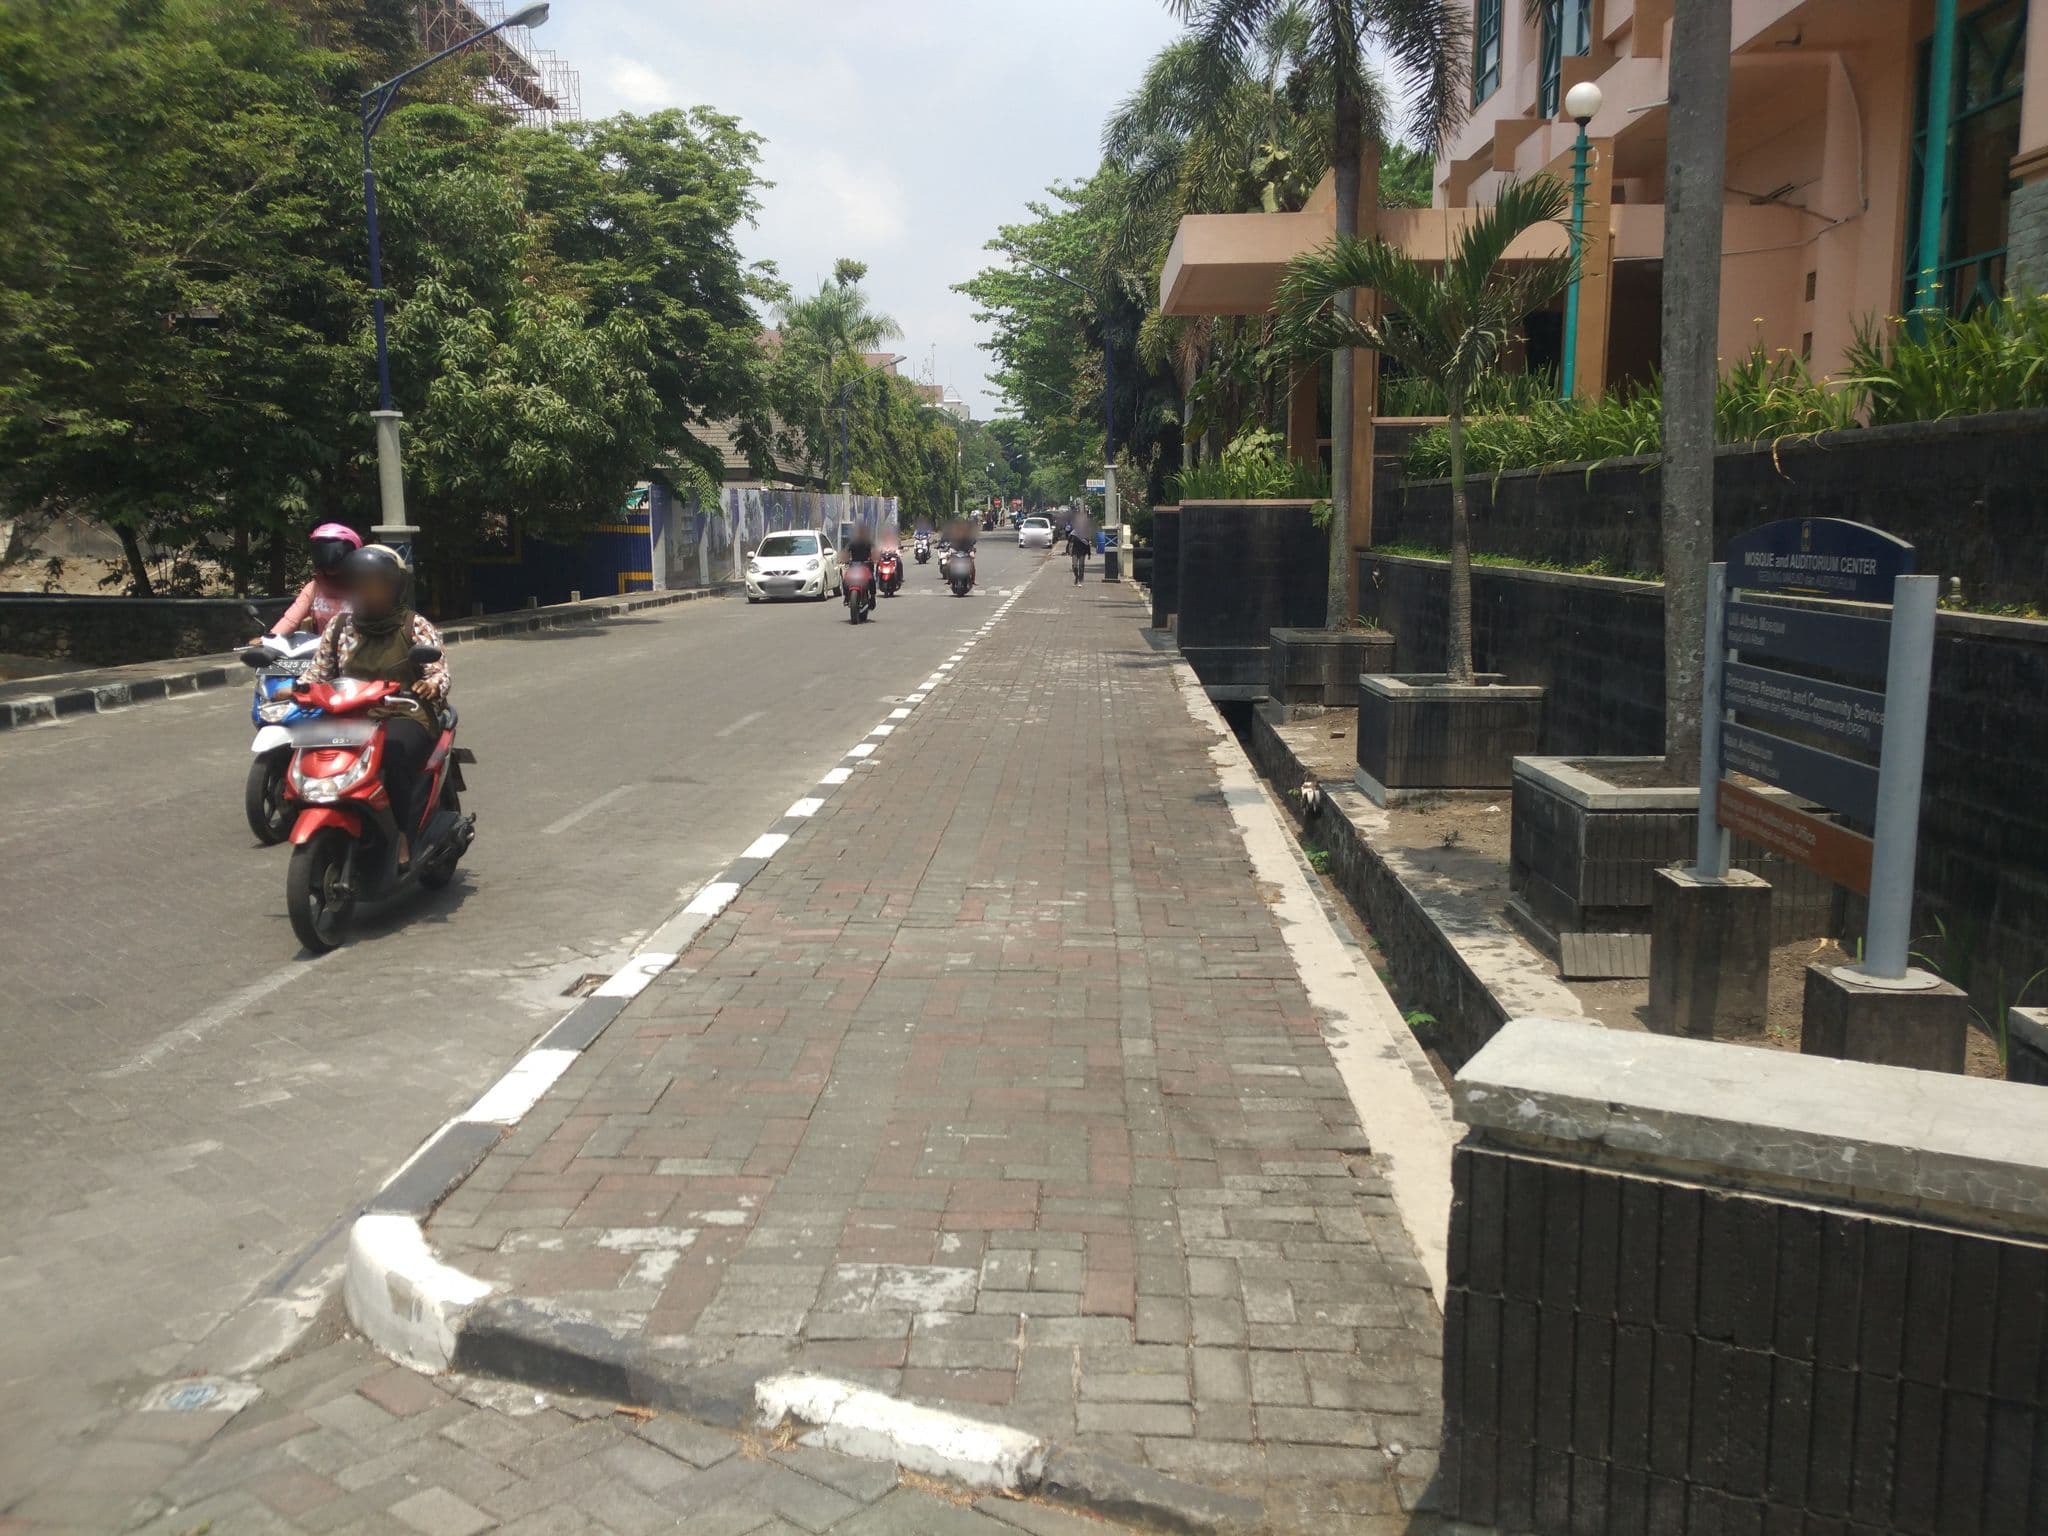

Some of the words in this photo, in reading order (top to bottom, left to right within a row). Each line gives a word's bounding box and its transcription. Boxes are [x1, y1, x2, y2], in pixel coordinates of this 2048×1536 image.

[1744, 552, 1775, 567] MOSQUE
[1775, 554, 1789, 568] and
[1789, 554, 1840, 572] AUDITORIUM
[1840, 557, 1877, 575] CENTER
[1760, 680, 1792, 699] Research
[1793, 688, 1807, 705] and
[1808, 692, 1853, 720] Community
